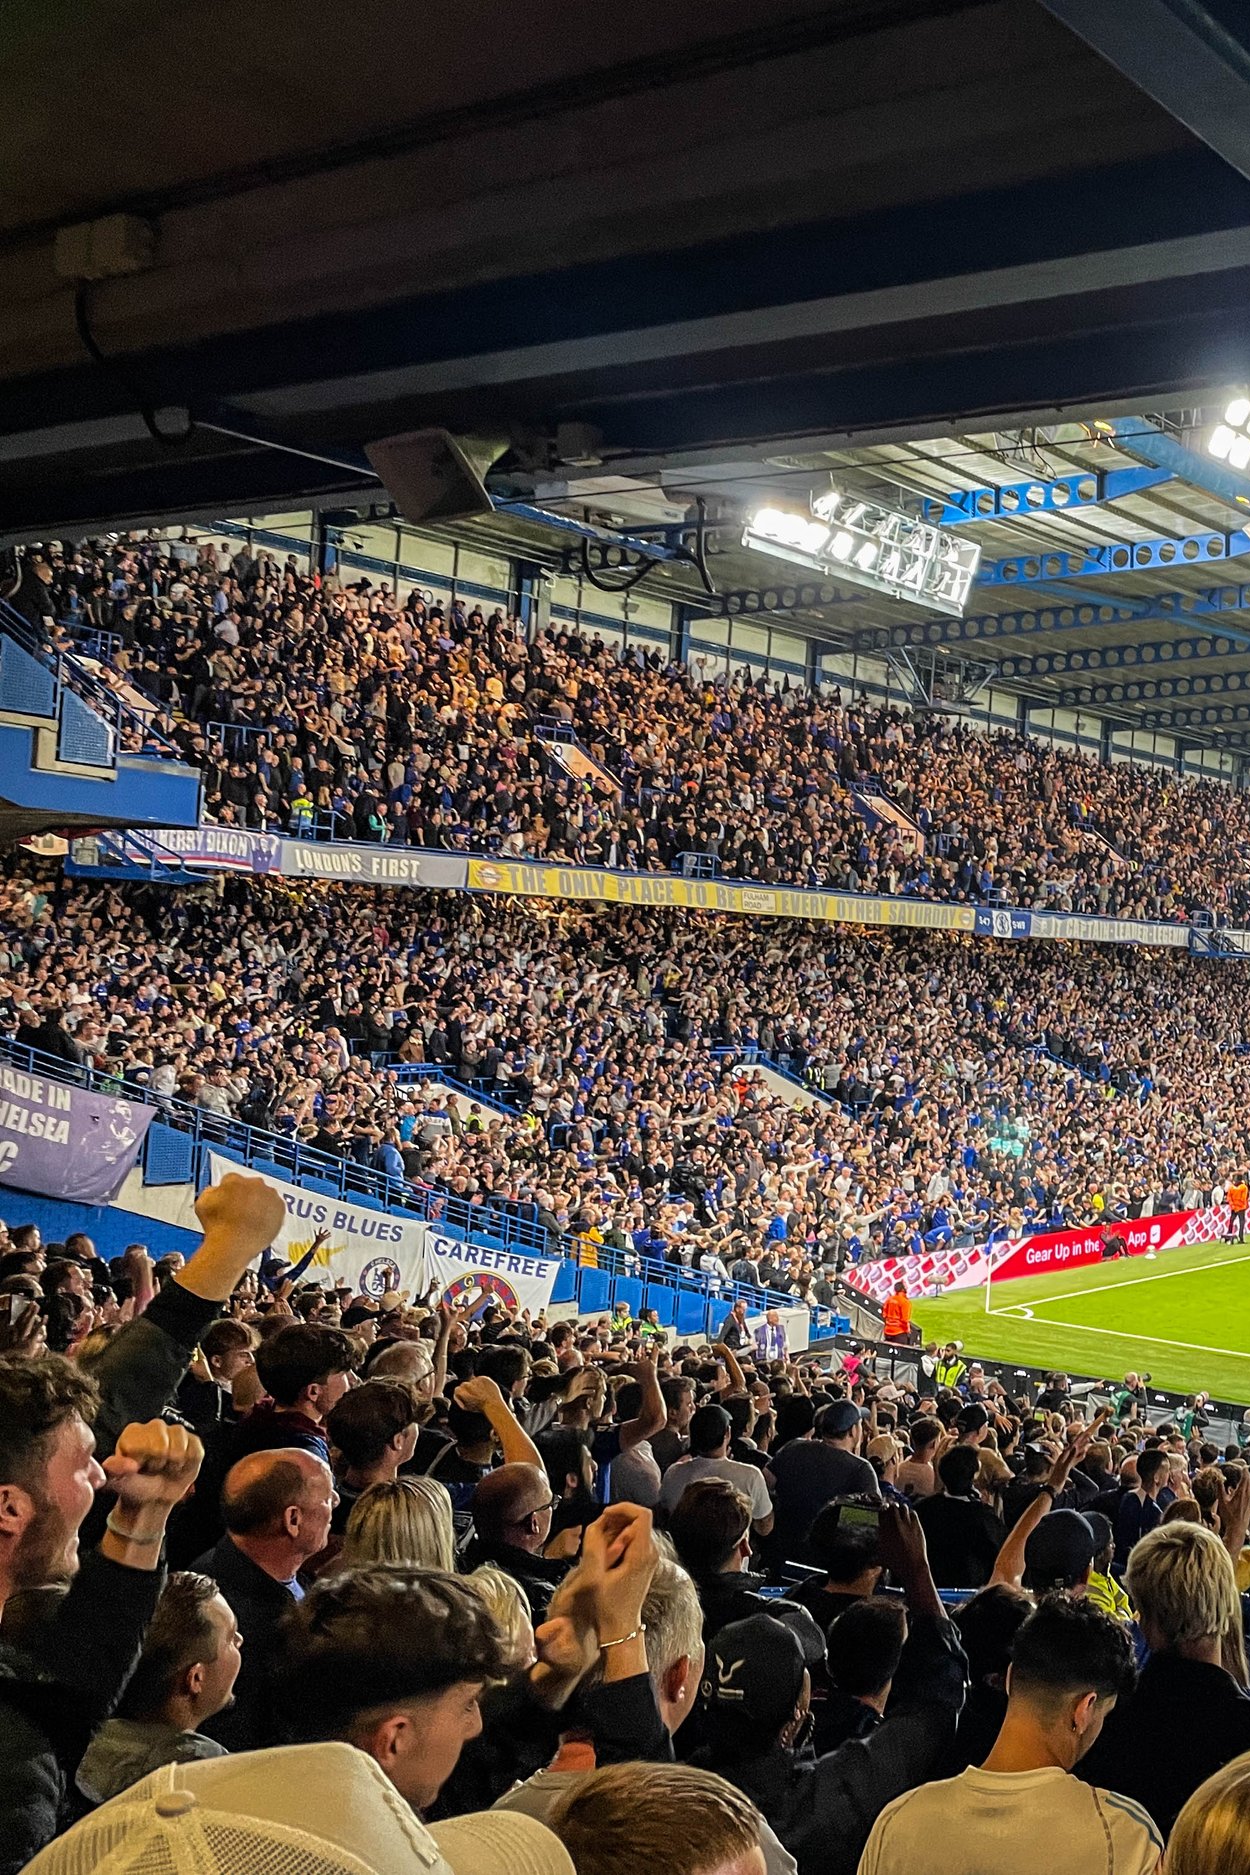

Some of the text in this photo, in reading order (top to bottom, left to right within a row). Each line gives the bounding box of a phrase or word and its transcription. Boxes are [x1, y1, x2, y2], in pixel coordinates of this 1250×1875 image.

[207, 831, 248, 856] DIXON
[295, 849, 422, 878] LONDON'S FIRST
[507, 866, 547, 893] THE
[559, 871, 606, 898] ONLY
[617, 878, 674, 904] PLACE
[683, 882, 707, 907] TO
[716, 887, 737, 909] BE
[743, 891, 770, 901] FULHAM
[744, 900, 761, 909] ROAD
[781, 892, 956, 927] EVERY OTHER SATURDAY
[1, 1068, 71, 1112] ADE IN
[282, 1193, 404, 1243] RUS BLUES
[434, 1238, 549, 1278] CAREFREE
[1025, 1231, 1147, 1264] Gear Up in the App
